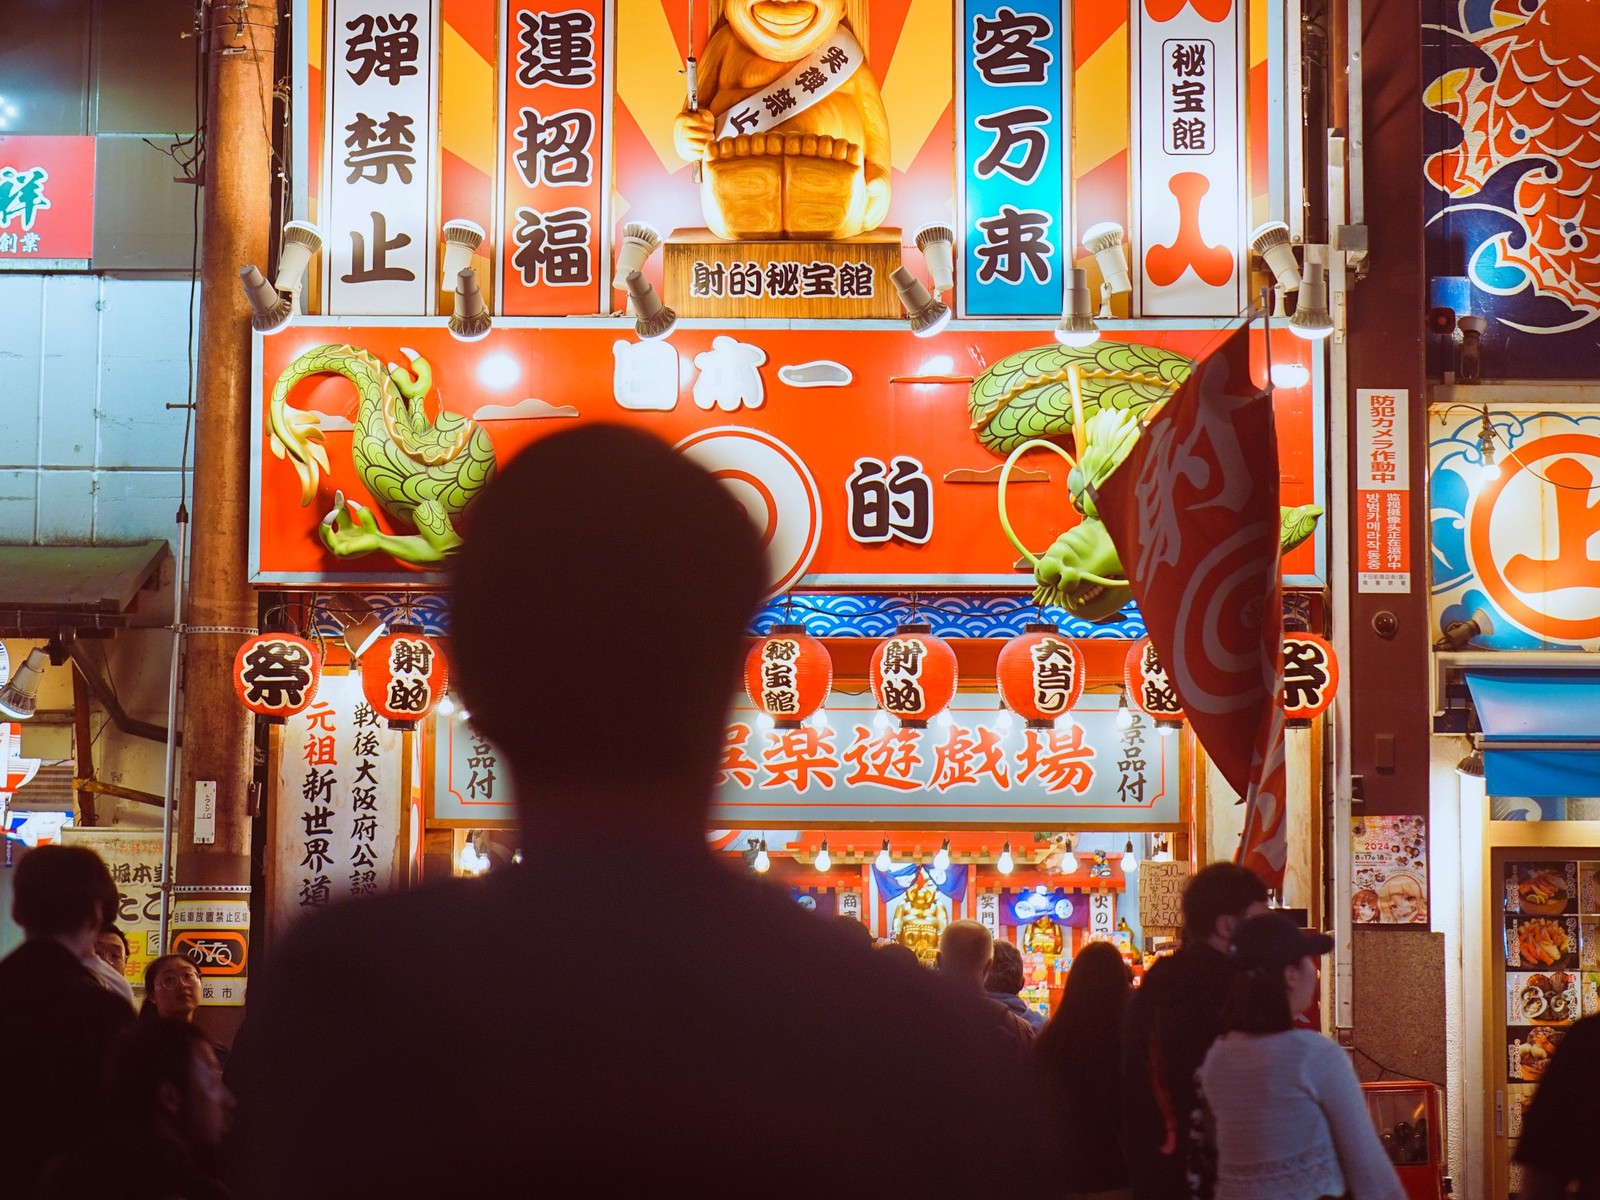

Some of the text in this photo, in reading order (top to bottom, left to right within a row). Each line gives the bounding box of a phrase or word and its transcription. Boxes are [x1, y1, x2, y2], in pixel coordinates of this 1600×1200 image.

[1172, 43, 1206, 150] 秘宝館
[692, 261, 874, 299] 射的秘宝館
[1370, 395, 1395, 484] 防犯カメラ作動中
[846, 456, 933, 543] 的
[1366, 493, 1381, 570] 방범카메라작동중
[244, 641, 311, 707] 祭
[763, 639, 800, 713] 秘宝館
[1031, 638, 1074, 713] 大当り
[349, 702, 381, 897] 戦後大阪府公認
[1365, 842, 1390, 850] 2024
